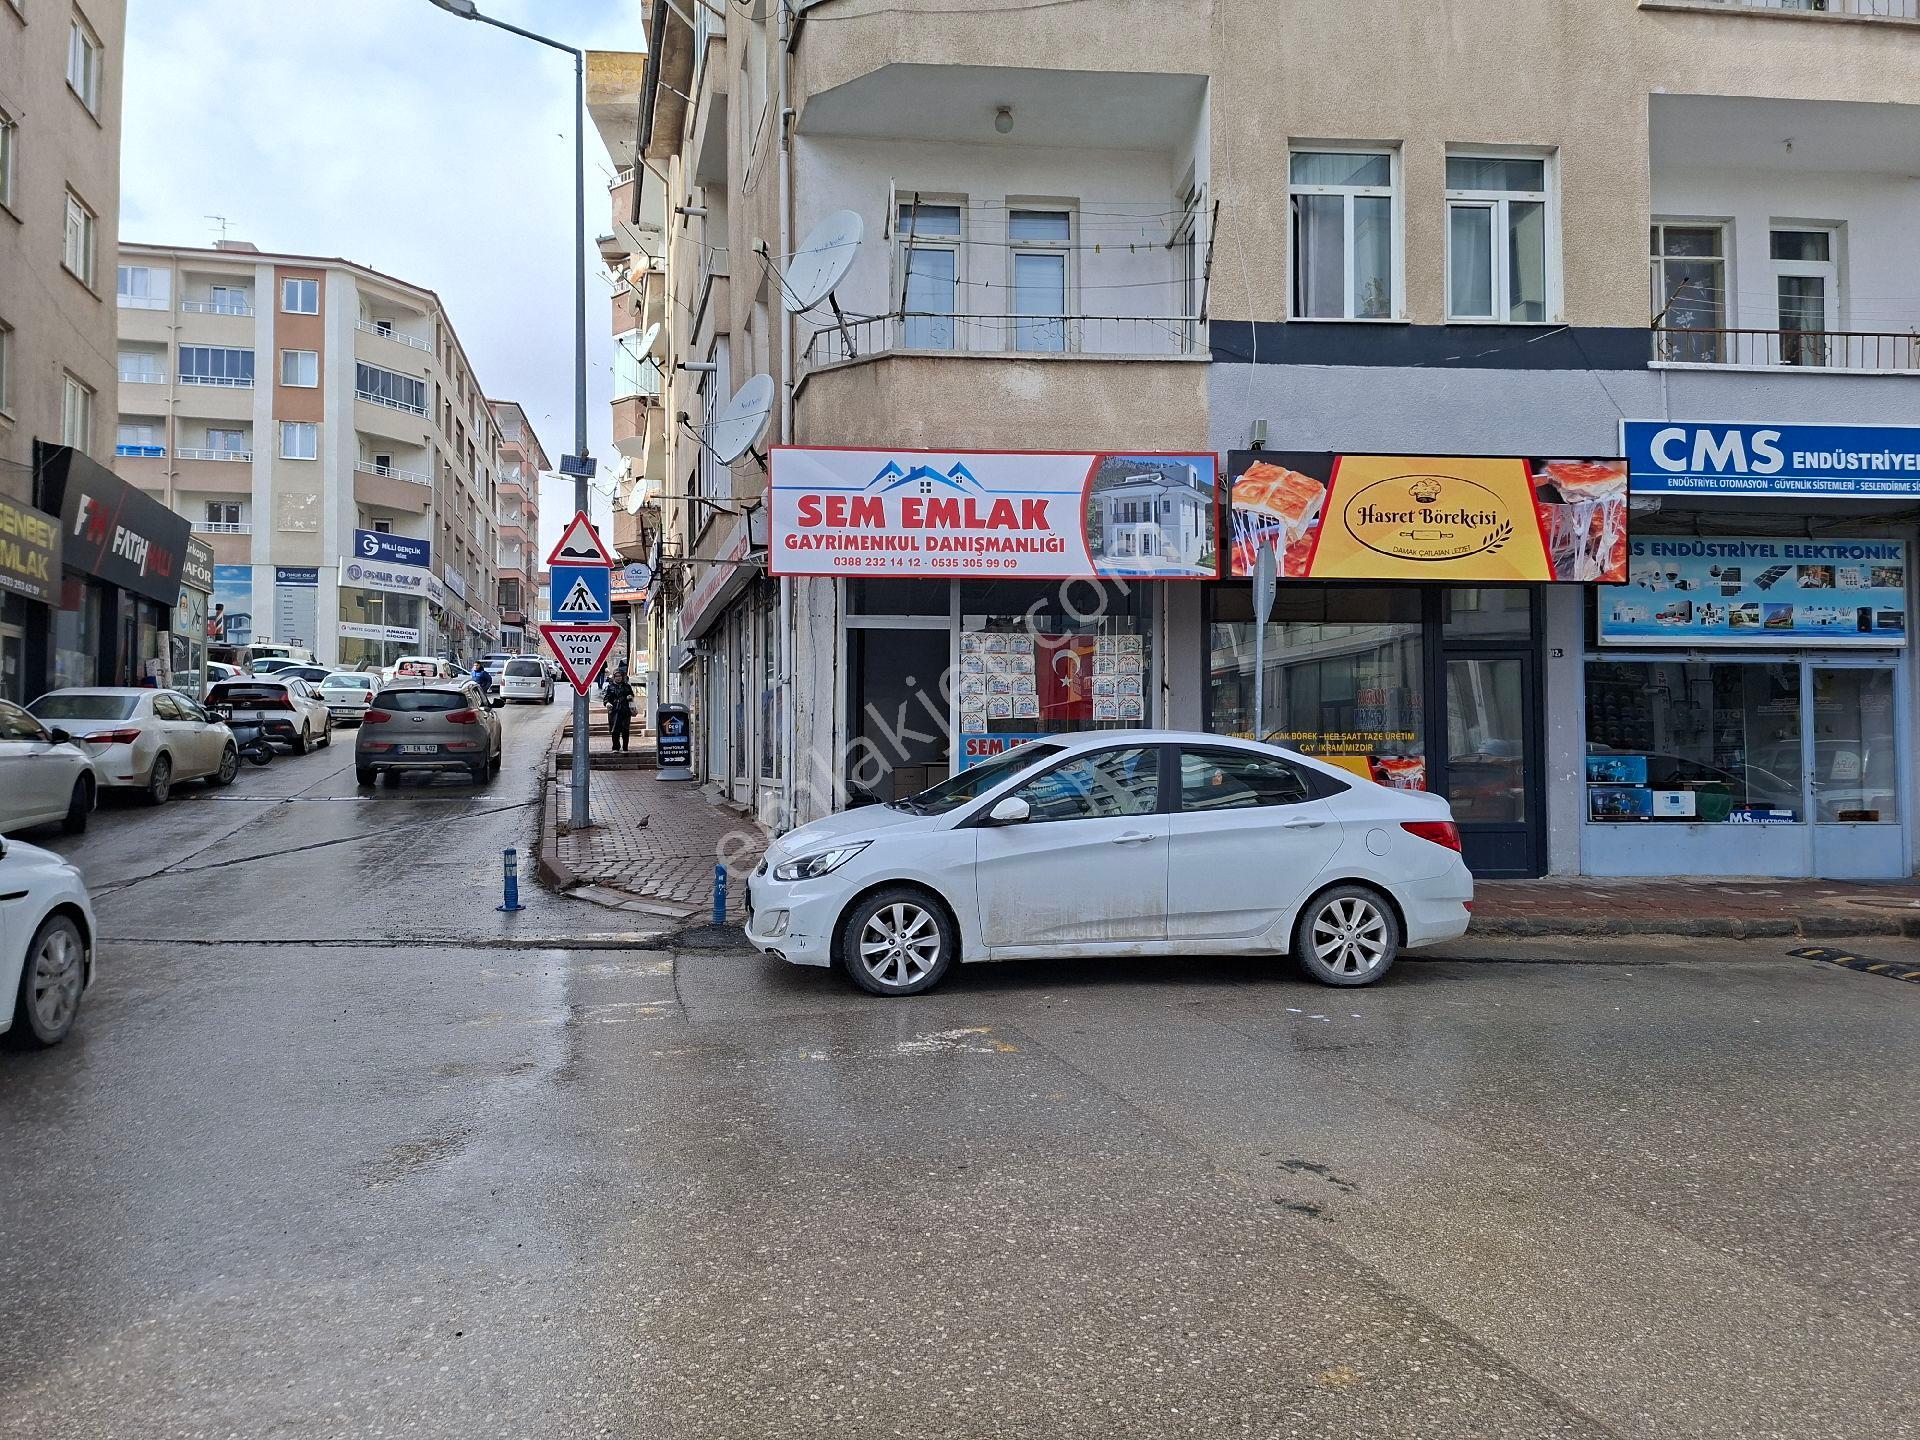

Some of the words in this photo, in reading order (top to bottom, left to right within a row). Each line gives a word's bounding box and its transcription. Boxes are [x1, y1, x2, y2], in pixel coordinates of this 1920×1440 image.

[1650, 428, 1785, 474] CMS
[1668, 477, 1717, 488] ENDÜSTRİYEL
[1719, 479, 1768, 489] OTOMASYON
[1774, 479, 1811, 490] GÜVENLİK
[1813, 480, 1855, 491] SİSTEMLERİ
[1860, 481, 1911, 491] SESLENDİRME
[798, 494, 886, 528] SEM
[901, 497, 1050, 531] EMLAK
[1357, 504, 1416, 527] Hasret
[1419, 508, 1496, 529] Börekçisi
[785, 530, 920, 551] GAYRİMENKUL
[926, 532, 1065, 556] DANIŞMANLIĞI
[1393, 545, 1417, 555] DAMAK
[1652, 540, 1779, 558] ENDÜSTRİYEL
[1784, 543, 1902, 560] ELEKTRONİK
[834, 556, 862, 566] 0388
[865, 557, 886, 567] 232
[890, 557, 903, 567] 14
[908, 558, 921, 567] 12
[931, 558, 959, 567] 0535
[962, 558, 983, 568] 305
[986, 559, 1000, 568] 99
[1004, 559, 1018, 568] 09
[560, 634, 601, 643] YAYAYA
[569, 646, 591, 654] YOL
[1364, 732, 1383, 741] TAZE
[966, 738, 1004, 756] SEM
